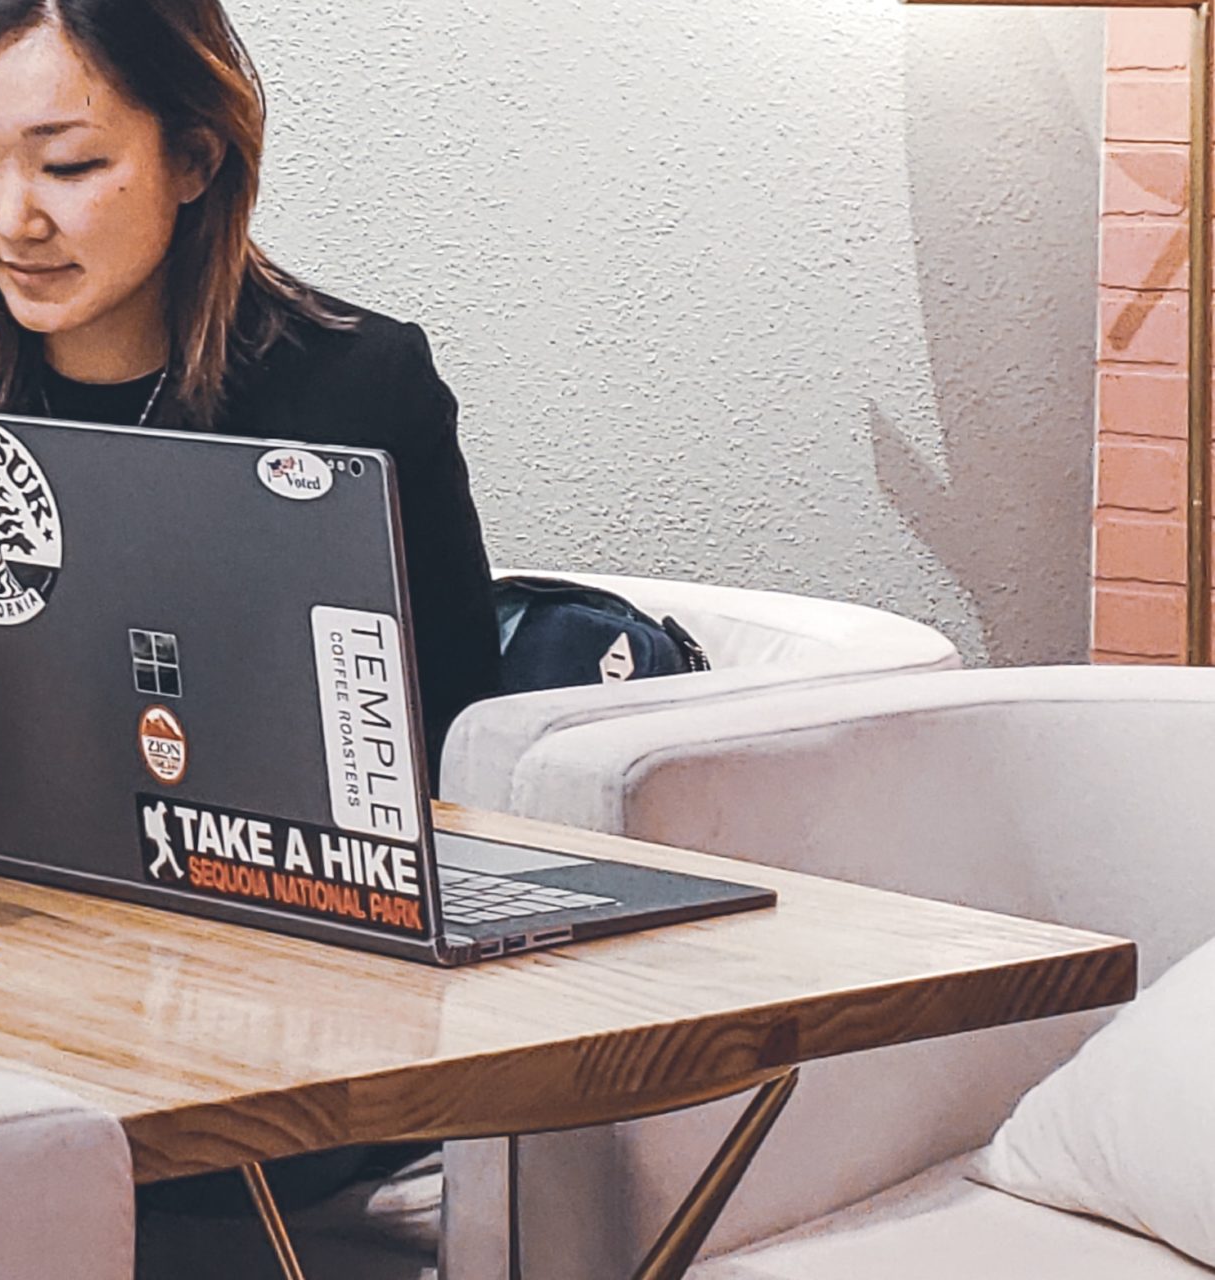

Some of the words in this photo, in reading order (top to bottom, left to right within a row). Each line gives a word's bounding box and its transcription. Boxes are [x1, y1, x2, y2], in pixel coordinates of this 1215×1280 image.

[283, 471, 322, 491] Voted
[330, 631, 350, 703] COFFEE
[147, 739, 181, 756] ZION
[338, 709, 361, 808] ROASTERS
[351, 619, 403, 832] TEMPLE
[173, 806, 276, 868] TAKE
[284, 826, 314, 876] A
[319, 832, 421, 896] HIKE
[188, 855, 270, 900] SEQUOIA
[272, 871, 366, 920] NATIONAL
[369, 892, 424, 931] PARK
